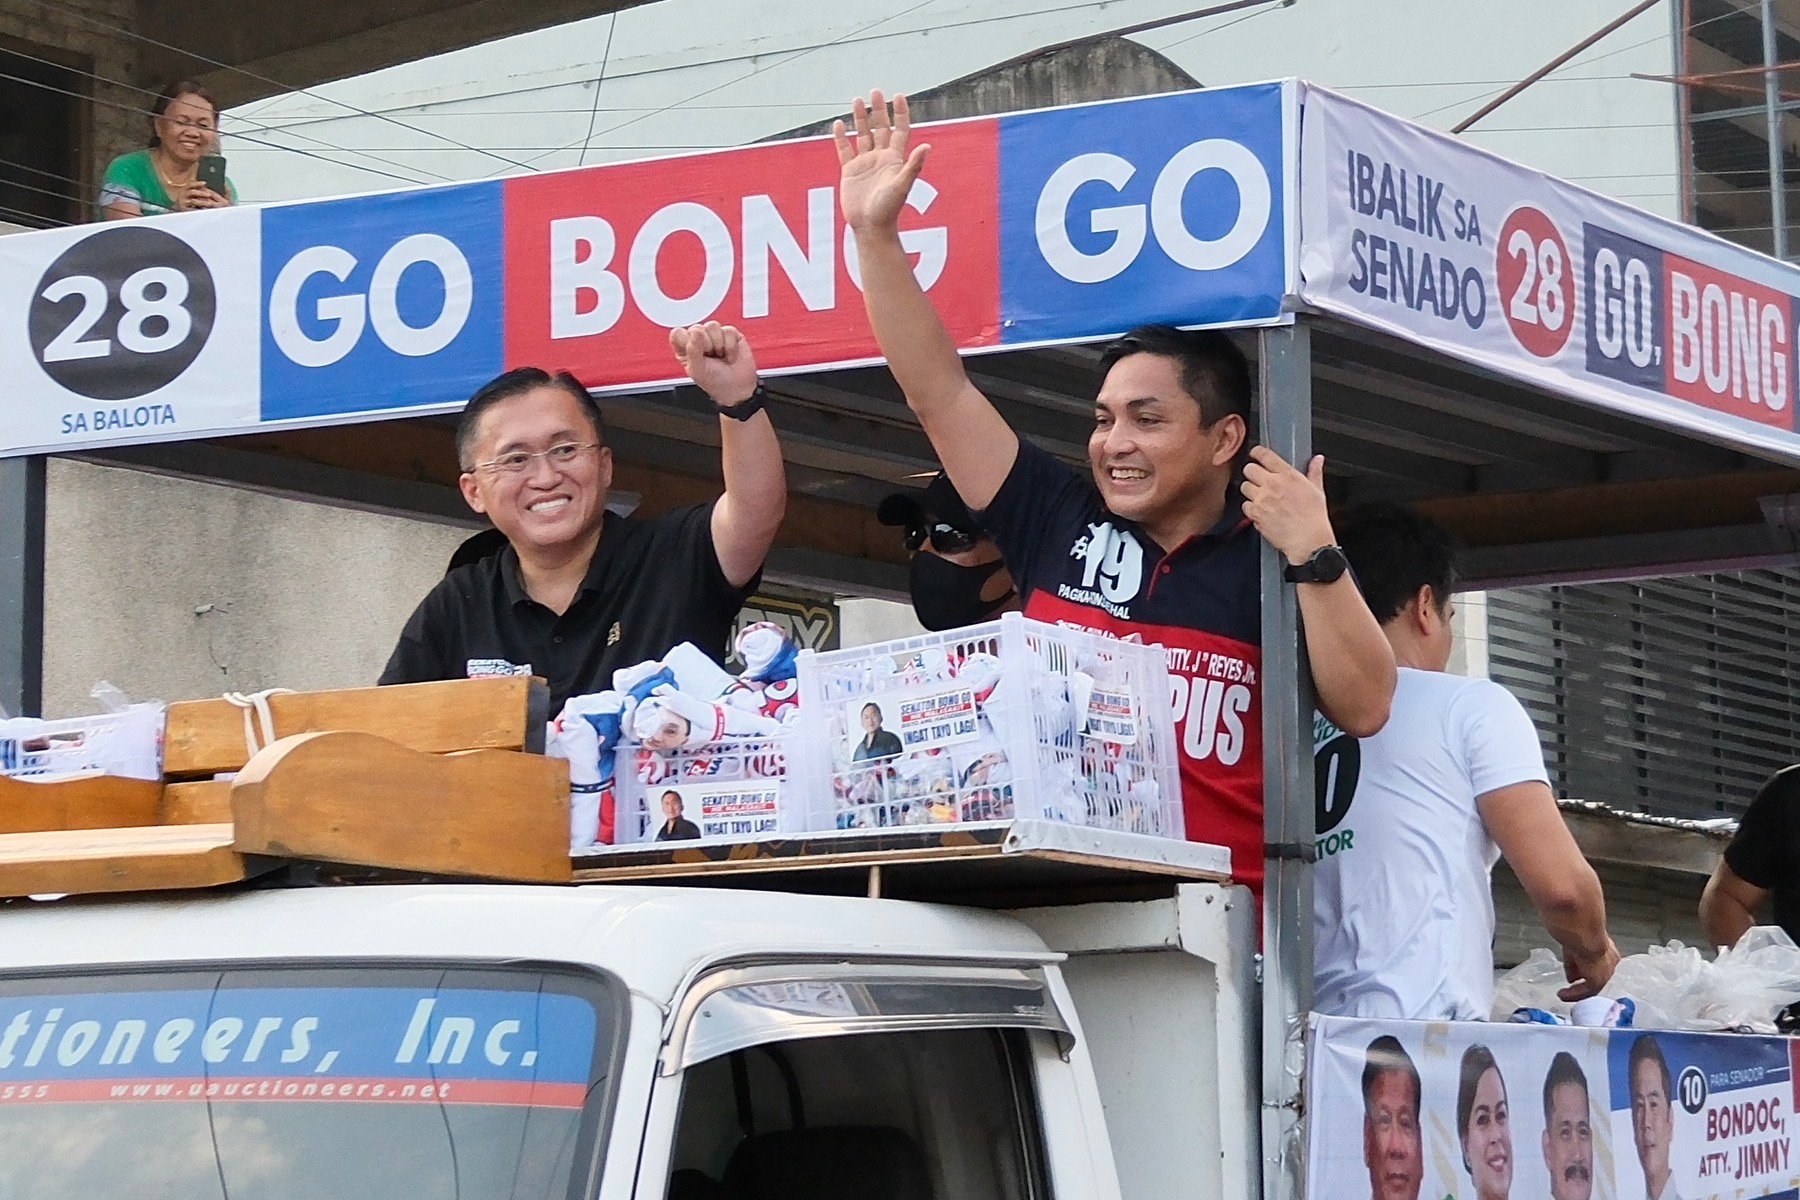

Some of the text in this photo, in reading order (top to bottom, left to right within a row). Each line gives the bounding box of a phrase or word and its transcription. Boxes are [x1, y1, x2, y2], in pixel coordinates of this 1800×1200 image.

[1348, 149, 1482, 246] IBALIK SA
[41, 138, 1272, 367] 28 GO BONG GO
[1348, 228, 1487, 330] SENADO
[1507, 229, 1564, 331] 28
[1594, 248, 1662, 367] GO,
[1671, 271, 1787, 411] BONG
[62, 404, 176, 434] SA BALOTA
[1207, 653, 1243, 681] REYES
[931, 723, 951, 740] TAYO
[731, 820, 752, 834] TAYO
[395, 998, 538, 1067] Inc.
[110, 1080, 450, 1099] www.uauctioneers.net
[1683, 1066, 1764, 1107] 10 PARA SENADOR
[1707, 1097, 1785, 1142] BONDOC,
[1699, 1137, 1790, 1180] ATTY. JIMMY
